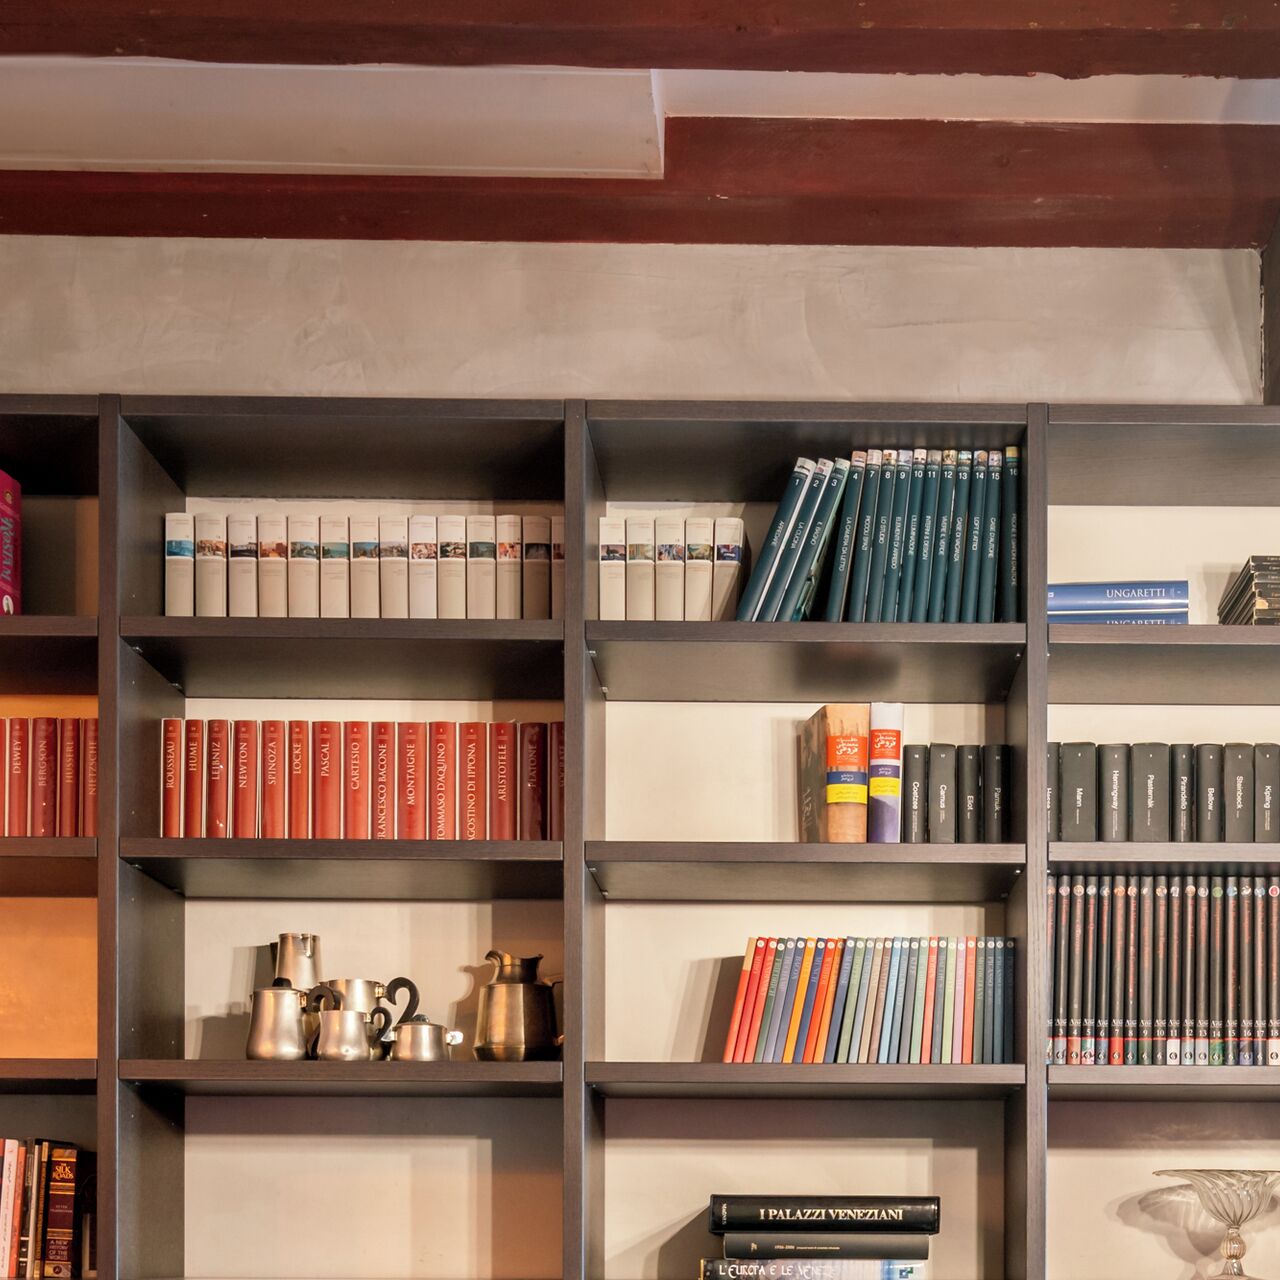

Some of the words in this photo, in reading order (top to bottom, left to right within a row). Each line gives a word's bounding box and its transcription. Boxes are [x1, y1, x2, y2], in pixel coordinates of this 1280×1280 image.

[914, 470, 923, 478] 10
[959, 472, 968, 480] 13
[790, 529, 802, 549] CUCINA
[797, 521, 804, 529] LA
[877, 524, 885, 543] STUDIO
[0, 517, 15, 582] ROSTAM
[838, 554, 846, 571] LETTO
[841, 546, 847, 554] DA
[1106, 588, 1166, 598] UNGARETTI
[13, 739, 21, 774] DEWEY
[38, 740, 48, 787] BERGSON
[66, 741, 74, 783] HUSSERL
[166, 741, 176, 788] ROUSSEAU
[189, 741, 198, 771] HUME
[212, 742, 221, 780] LEIBNIZ
[240, 742, 248, 788] NEWTON
[268, 742, 276, 785] SPINOZA
[293, 743, 302, 774] LOCKE
[321, 742, 330, 777] PASCAL
[351, 742, 360, 790] CARTESIO
[378, 743, 387, 782] BACONE
[437, 743, 447, 791] D'AQUINO
[467, 743, 476, 775] IPPONA
[407, 743, 415, 805] MONTAIGNE
[468, 780, 476, 791] DI
[498, 744, 507, 801] ARISTOTELE
[1111, 770, 1119, 809] Hemingway
[1147, 774, 1155, 808] Pasternak
[1180, 776, 1188, 810] Pirandello
[1263, 785, 1271, 809] Kipling
[1199, 1029, 1207, 1037] 13
[52, 1172, 73, 1180] ROADS
[55, 1166, 71, 1174] SILK
[760, 1209, 765, 1220] I
[766, 1209, 825, 1220] PALAZZI
[829, 1209, 903, 1221] VENEZIANI
[781, 1264, 793, 1276] LE
